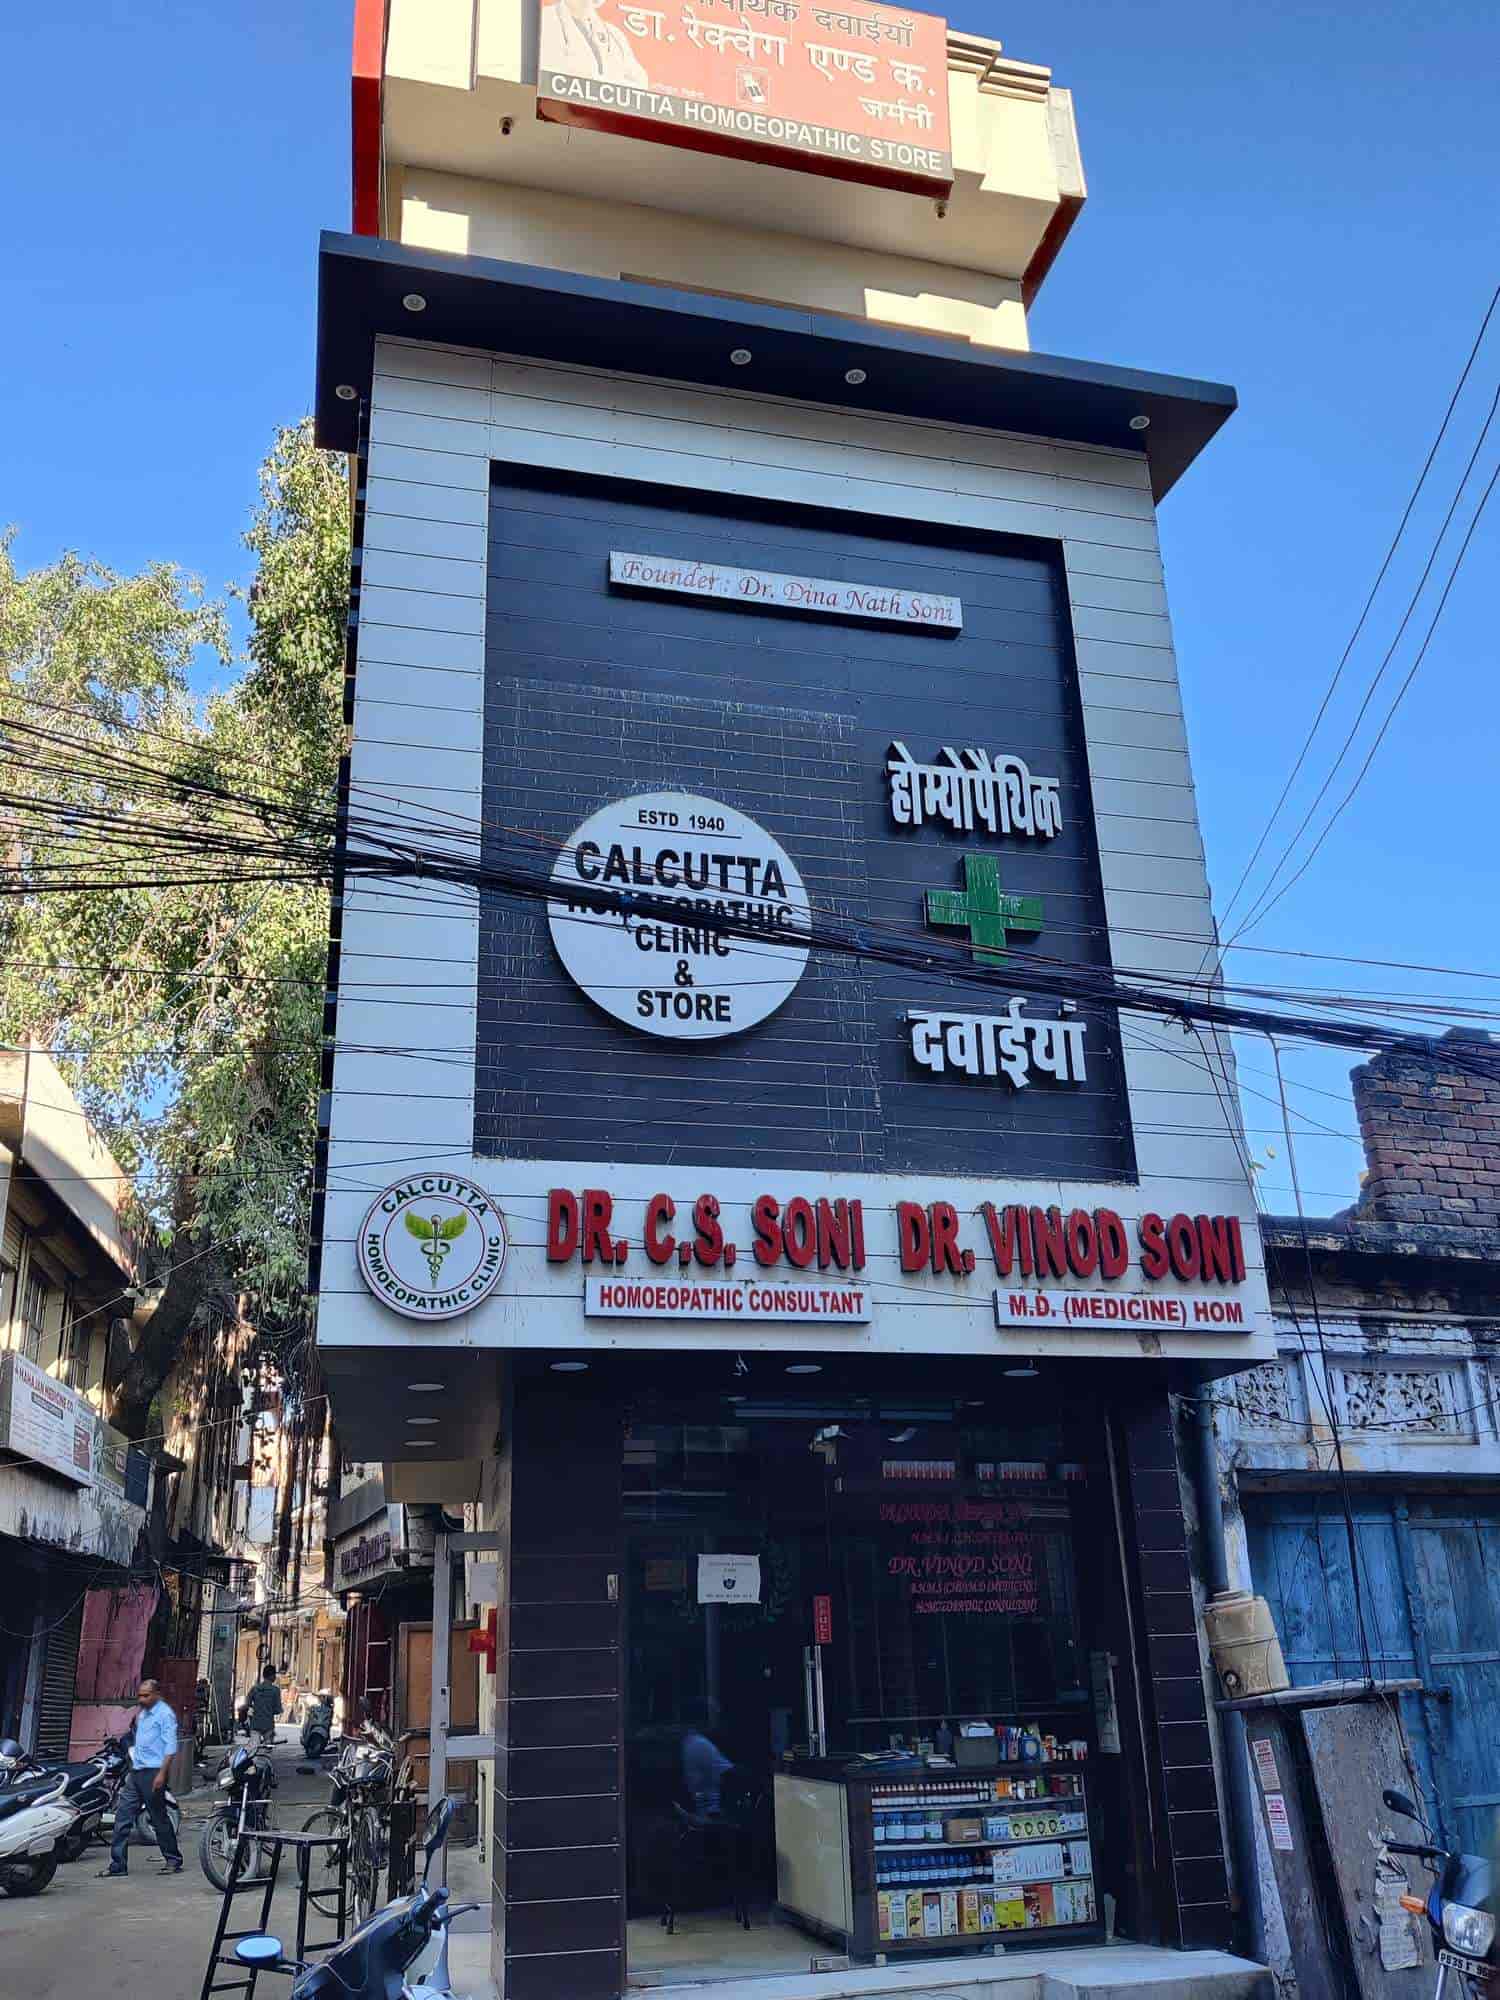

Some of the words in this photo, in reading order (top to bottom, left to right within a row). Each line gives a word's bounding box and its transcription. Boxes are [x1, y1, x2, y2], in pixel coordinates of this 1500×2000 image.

[617, 3, 676, 43] डा.
[805, 40, 878, 82] एण्ड
[889, 57, 937, 97] क.
[551, 74, 673, 117] CALCUTTA
[684, 99, 862, 155] HOMOEOPATHIC
[870, 140, 943, 172] STORE
[857, 95, 935, 130] जर्मनी
[739, 575, 775, 598] Dr.
[783, 582, 837, 608] Dina
[845, 590, 900, 615] Nath
[906, 597, 954, 622] Soni
[887, 741, 1063, 838] होम्योपैथिक
[638, 809, 679, 827] ESTD
[689, 814, 725, 831] 1940
[574, 840, 788, 898] CALCUTTA
[567, 888, 793, 928] HOMOPATHIC
[634, 924, 731, 958] CLINIC
[673, 960, 694, 987] &
[636, 990, 732, 1023] STORE
[904, 997, 1086, 1088] दवाईयां
[381, 1179, 489, 1216] CALCUTTA
[547, 1188, 628, 1265] DR.
[645, 1193, 737, 1267] C.S.
[751, 1194, 866, 1270] SONI
[896, 1201, 975, 1274] DR.
[982, 1200, 1129, 1280] VINOD
[1138, 1212, 1247, 1283] SONI
[368, 1233, 471, 1309] HOMOEOPATHIC
[471, 1236, 501, 1291] CLINIC
[600, 1285, 743, 1312] HOMOEOPATHIC
[750, 1289, 864, 1315] CONSULTANT
[1009, 1295, 1057, 1317] M.D.
[1064, 1297, 1187, 1328] (MEDICINE)
[1193, 1301, 1243, 1323] HOM
